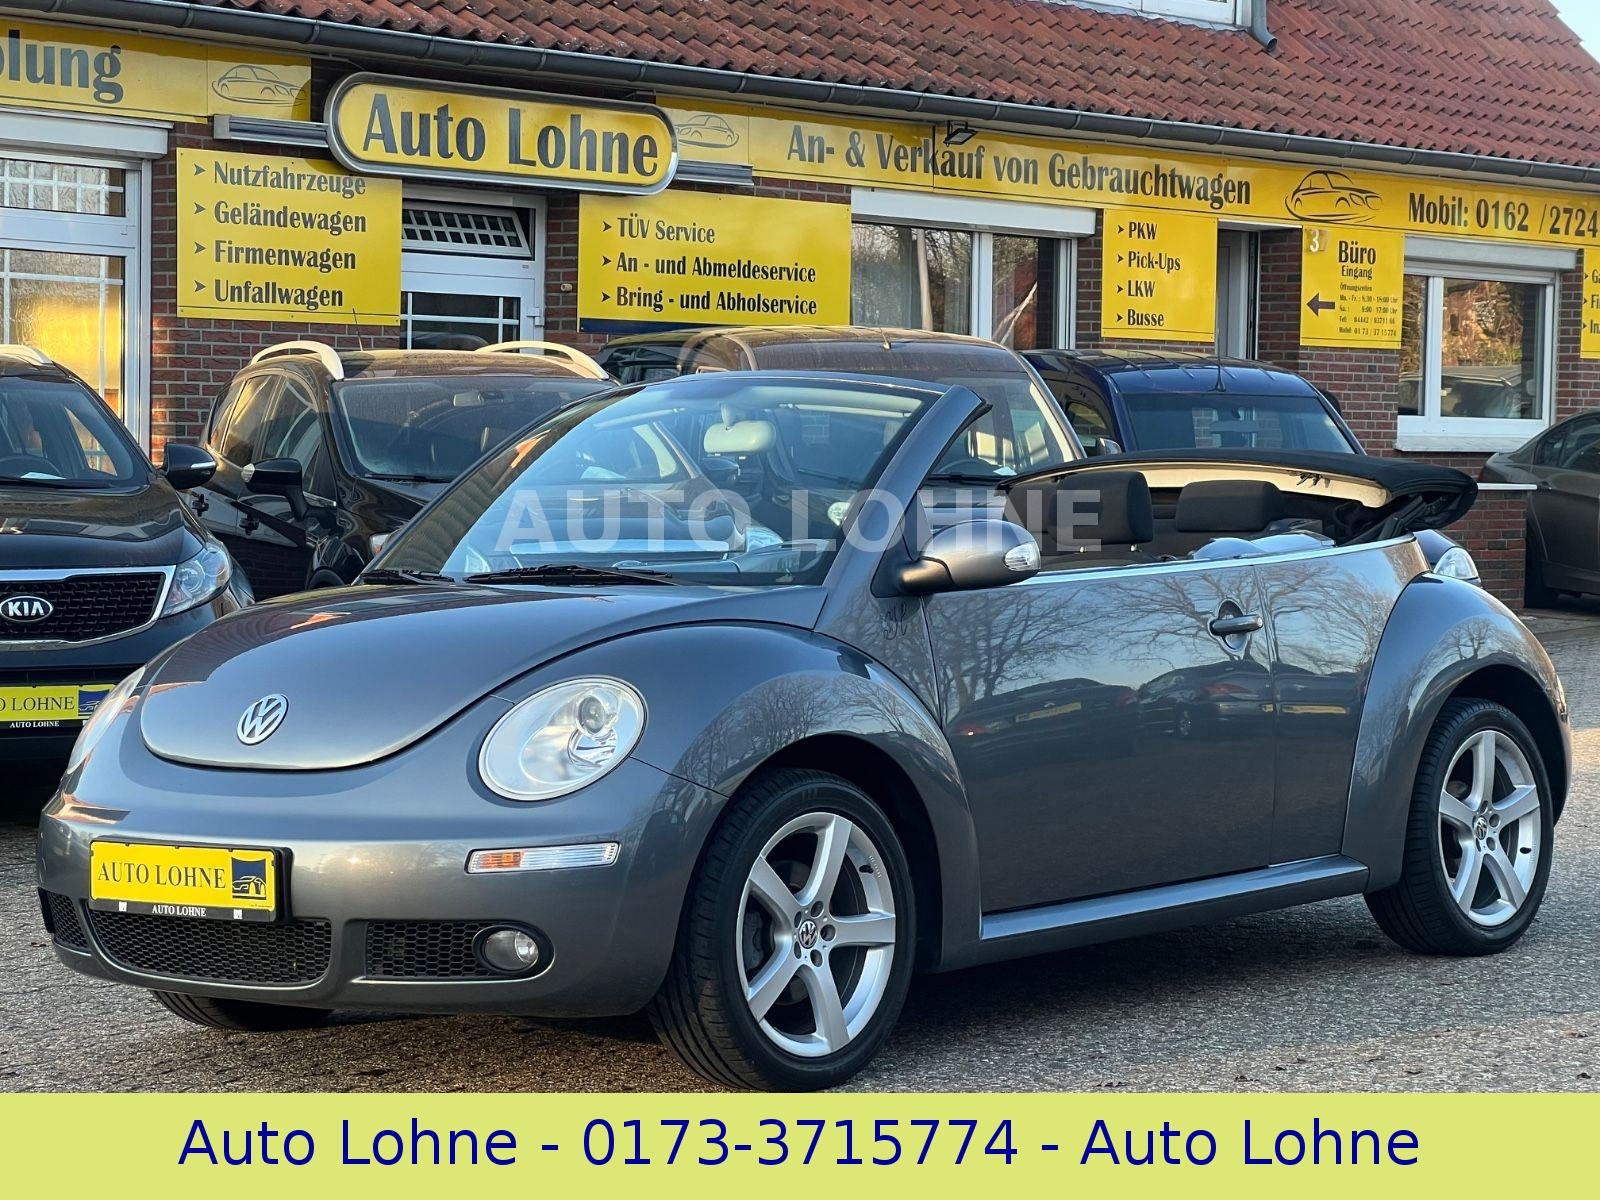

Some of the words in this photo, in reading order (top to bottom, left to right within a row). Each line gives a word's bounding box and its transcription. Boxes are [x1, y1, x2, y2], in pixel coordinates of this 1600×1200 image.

[363, 93, 486, 162] Auto
[508, 108, 659, 177] Lohne
[214, 160, 366, 199] Nutzfahrzeuge
[787, 124, 835, 164] An-
[845, 131, 865, 168] &
[875, 133, 986, 180] Verkauf
[993, 154, 1039, 185] von
[1049, 153, 1252, 210] Gebrauchtwagen
[214, 200, 367, 237] Geländewagen
[1408, 192, 1469, 228] Mobil:
[1475, 199, 1529, 232] 0162
[617, 212, 650, 239] TÜV
[655, 219, 715, 244] Service
[1128, 221, 1158, 241] PKW
[214, 239, 357, 274] Firmenwagen
[1127, 251, 1181, 273] Pick-Ups
[1339, 240, 1376, 265] Büro
[616, 251, 638, 272] An
[655, 255, 686, 275] und
[692, 256, 816, 284] Abmeldeservice
[1341, 265, 1373, 280] Eingang
[214, 279, 344, 311] Unfallwagen
[616, 286, 664, 313] Bring
[680, 290, 710, 310] und
[716, 293, 817, 316] Abholservice
[1127, 280, 1156, 298] LKW
[1127, 308, 1165, 328] Busse
[8, 601, 45, 618] KIA
[12, 696, 75, 711] LOHNE
[32, 720, 60, 728] LOHNE
[97, 861, 150, 885] AUTO
[156, 863, 226, 889] LOHNE
[152, 904, 173, 915] AUTO
[174, 906, 207, 917] LOHNE
